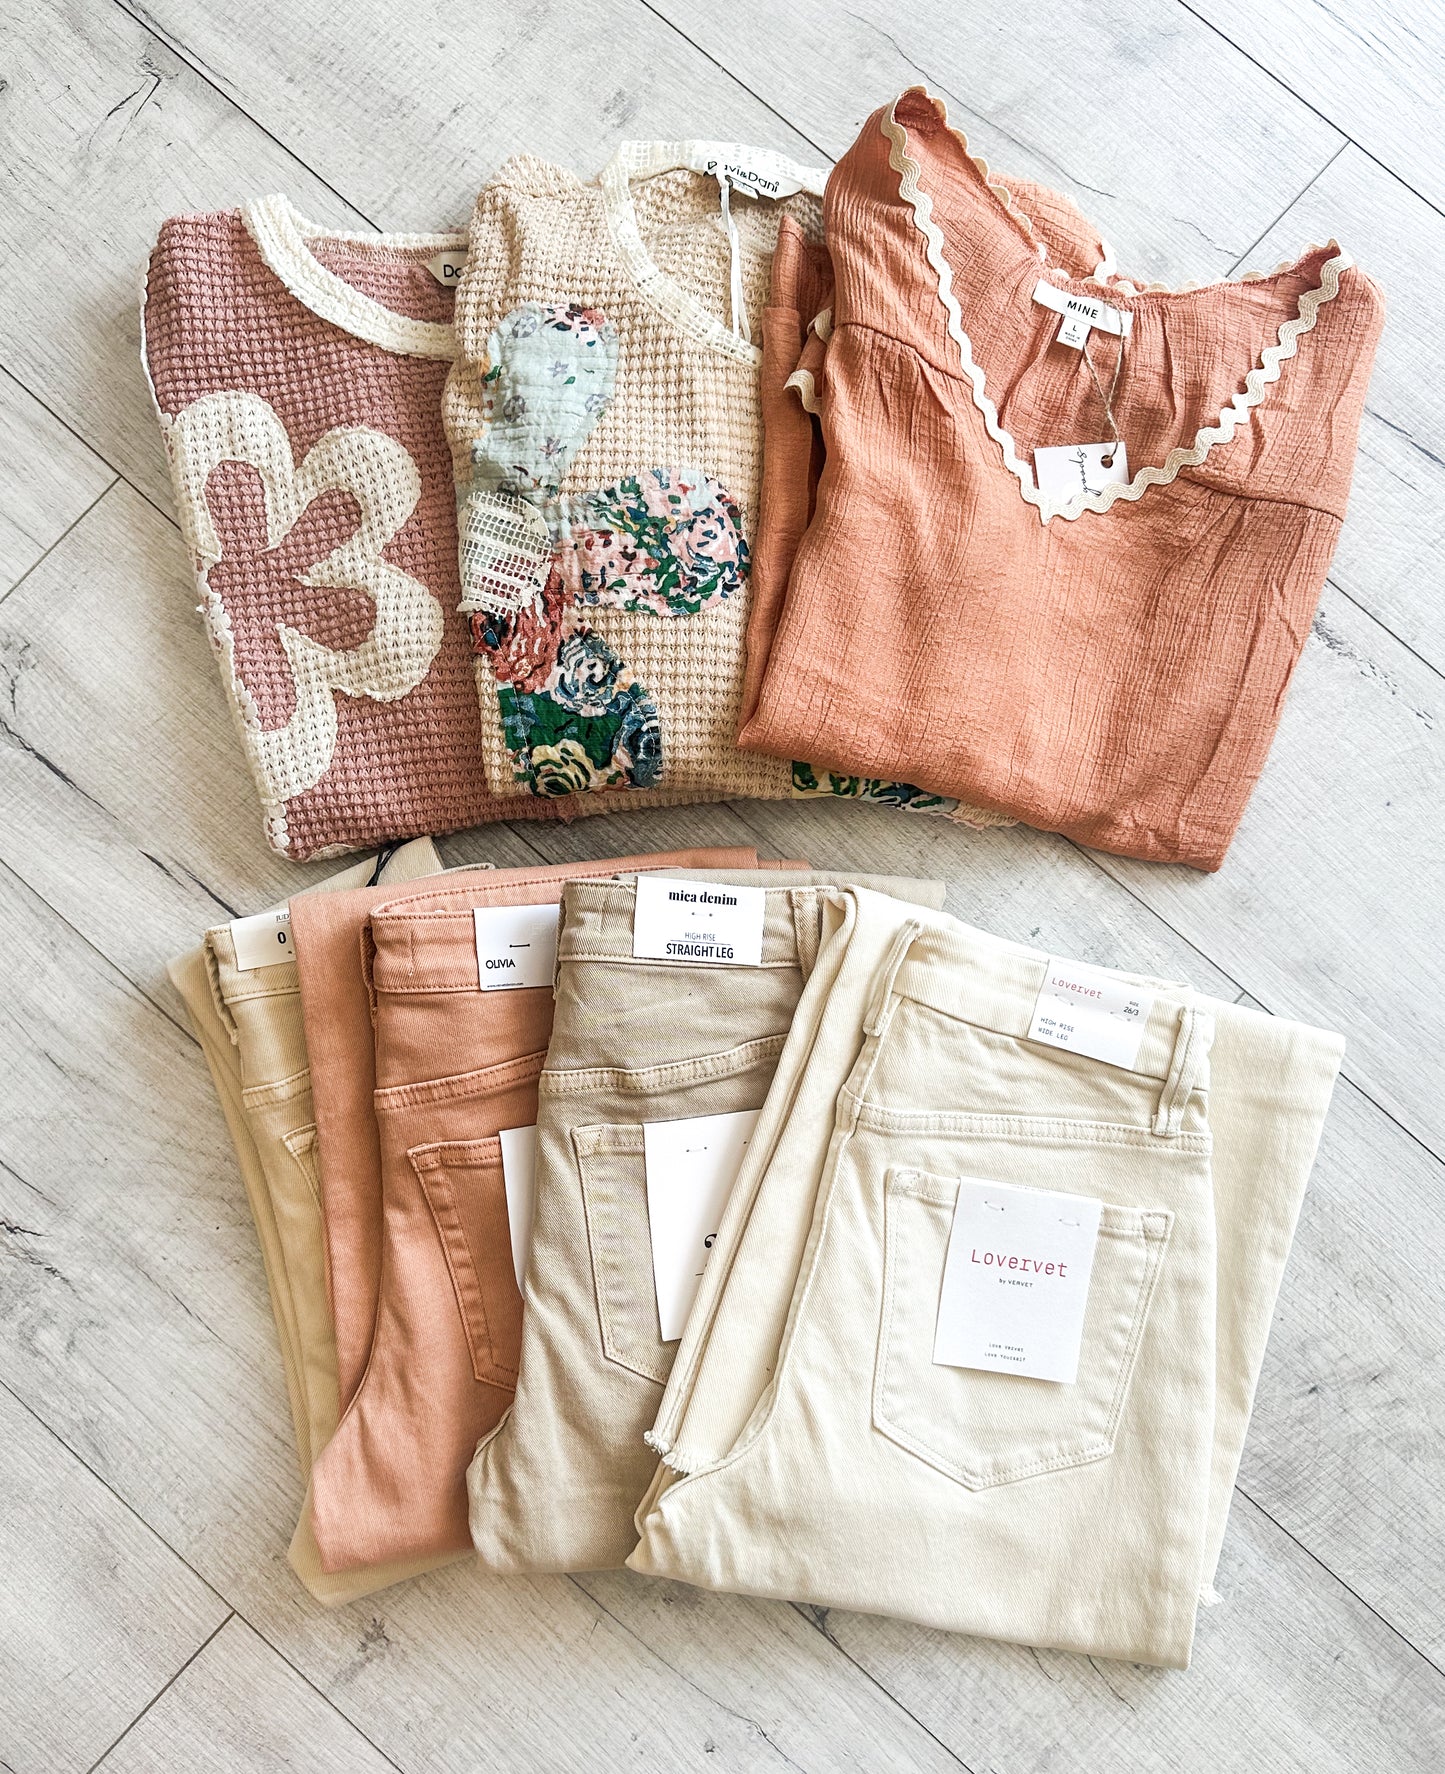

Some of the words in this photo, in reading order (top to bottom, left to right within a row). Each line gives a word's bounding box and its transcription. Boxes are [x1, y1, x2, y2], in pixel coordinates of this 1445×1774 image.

[1066, 300, 1099, 319] MINE
[668, 890, 697, 903] mica
[699, 891, 738, 906] denim
[277, 931, 287, 944] 0
[684, 932, 701, 941] HIGH
[702, 933, 716, 942] RISE
[666, 943, 714, 958] STRAIGHT
[716, 946, 734, 959] LEG
[485, 958, 516, 969] OLIVIA
[1051, 977, 1103, 1000] Lovervet
[1123, 1006, 1139, 1016] 26/3
[1040, 1017, 1056, 1027] HIGH
[1059, 1022, 1075, 1033] RISE
[1037, 1027, 1053, 1037] WIDE
[1056, 1032, 1069, 1041] LEG
[970, 1249, 1068, 1278] Lovervet
[1008, 1279, 1034, 1288] VERVET
